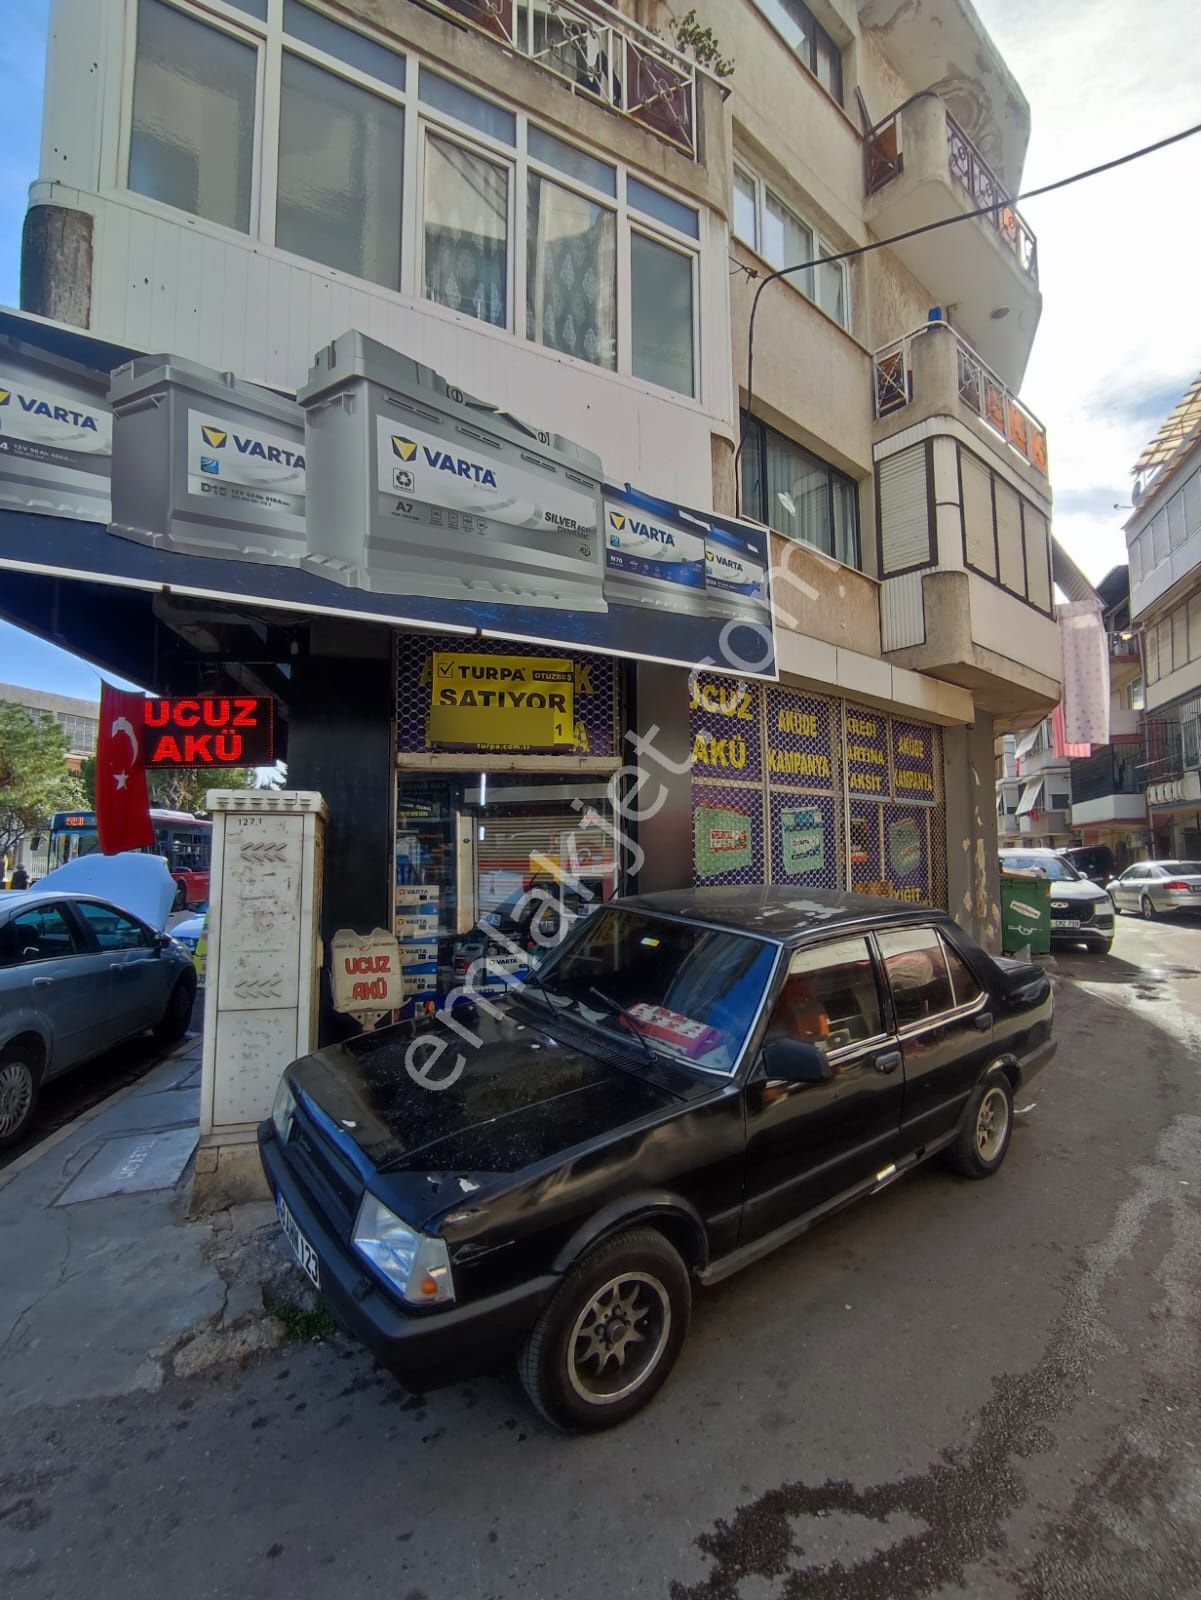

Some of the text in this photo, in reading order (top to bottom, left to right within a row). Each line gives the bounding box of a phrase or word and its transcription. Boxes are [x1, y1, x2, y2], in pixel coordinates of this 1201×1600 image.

[17, 394, 98, 432] VARTA
[232, 435, 306, 471] VARTA
[423, 446, 497, 488] VARTA
[545, 511, 577, 530] SILVER
[628, 519, 676, 547] VARTA
[716, 555, 743, 572] VARTA
[458, 666, 525, 682] TURPA
[144, 700, 257, 727] UCUZ
[440, 688, 567, 713] SATIYOR
[152, 729, 242, 762] AKÜ
[691, 733, 747, 769] AKÜ
[344, 956, 392, 975] UCUZ
